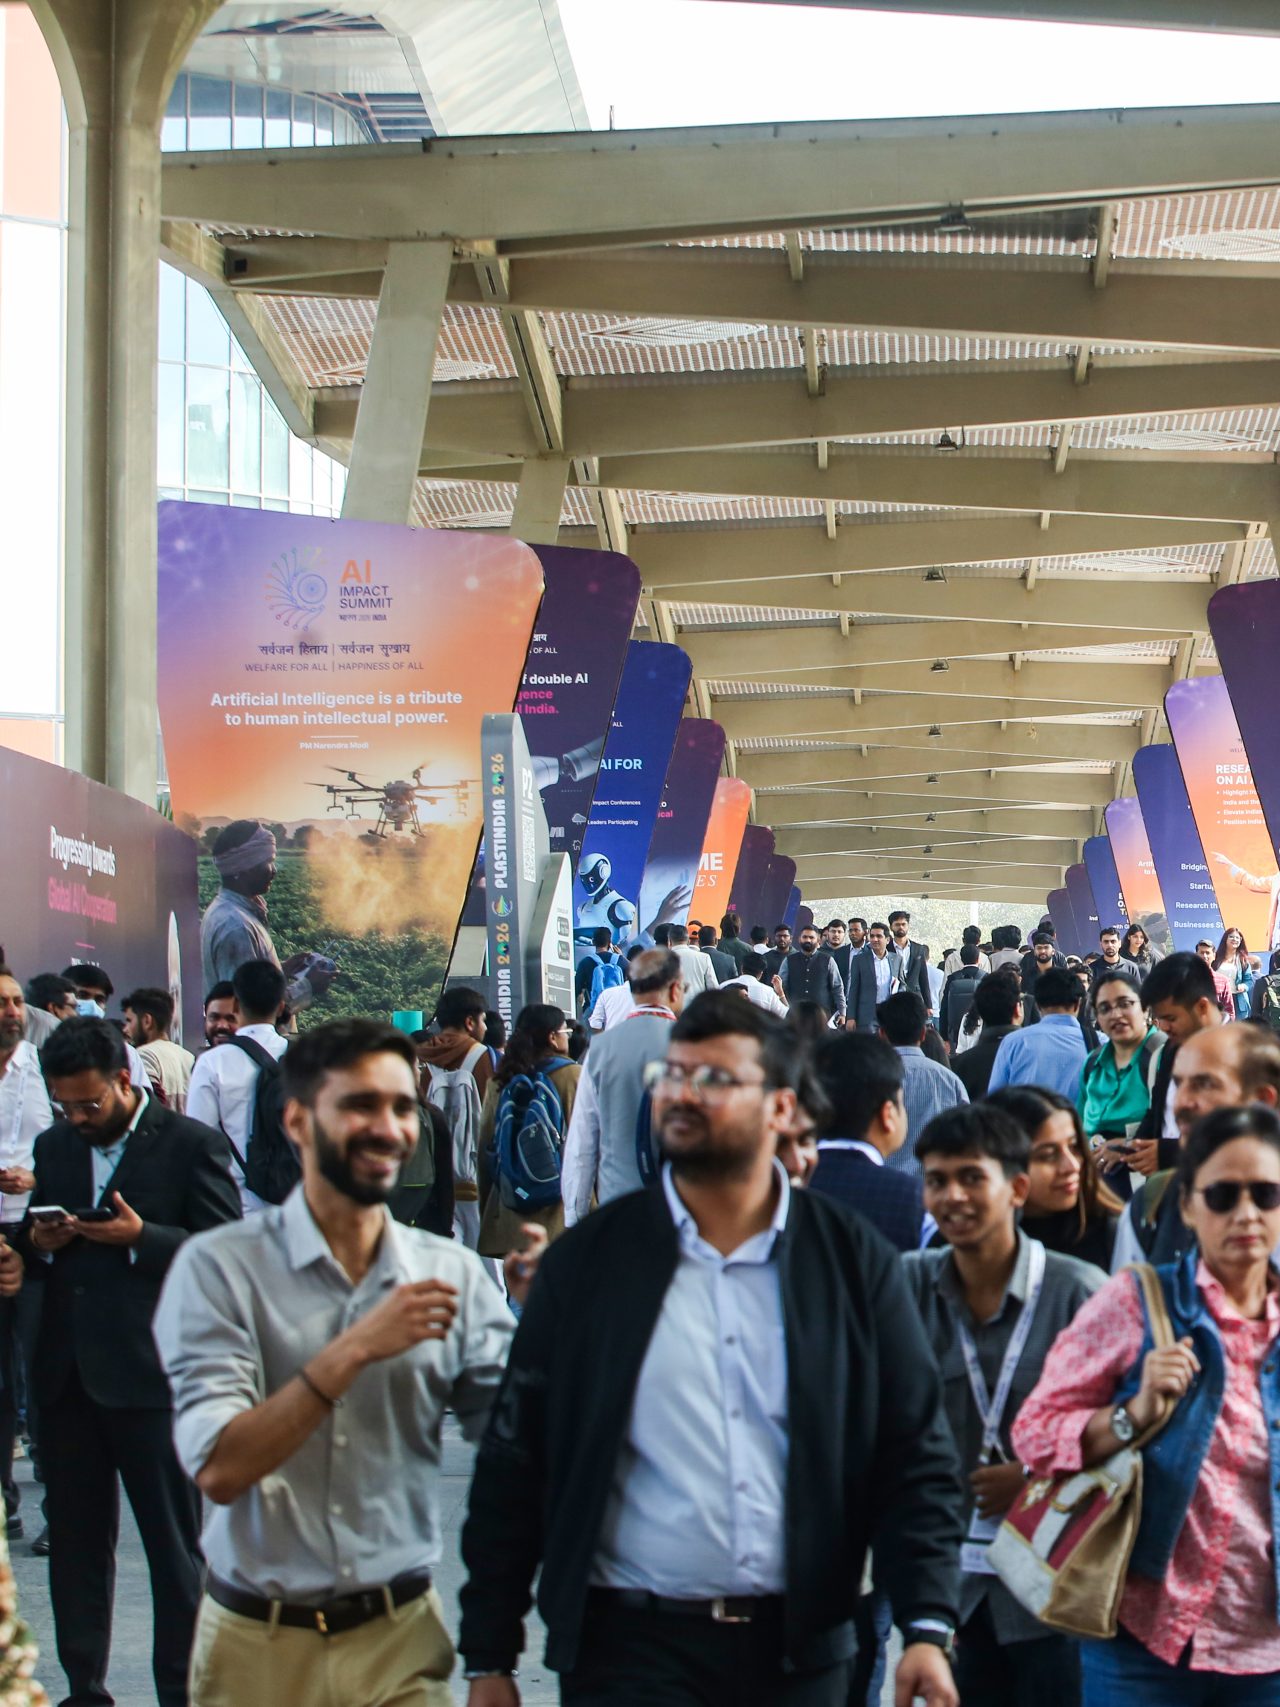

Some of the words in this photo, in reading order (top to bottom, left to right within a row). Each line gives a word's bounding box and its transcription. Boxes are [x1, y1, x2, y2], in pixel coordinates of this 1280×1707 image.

[341, 559, 371, 583] AI
[340, 585, 389, 597] IMPACT
[340, 597, 393, 608] SUMMIT
[299, 641, 328, 655] हिताय
[245, 663, 288, 671] WELFARE
[290, 663, 309, 672] FOR
[311, 663, 328, 671] ALL
[338, 662, 390, 671] HAPPINESS
[392, 662, 405, 670] OF
[407, 662, 424, 670] ALL
[529, 673, 572, 685] double
[575, 672, 588, 683] AI
[210, 692, 278, 706] Artificial
[282, 691, 374, 708] Intelligence
[379, 691, 392, 705] is
[396, 694, 405, 705] a
[409, 690, 463, 704] tribute
[525, 703, 559, 714] India.
[225, 712, 241, 725] to
[245, 712, 299, 726] human
[303, 711, 391, 725] intellectual
[395, 711, 448, 726] power.
[614, 759, 642, 770] FOR
[522, 767, 533, 800] P2
[1216, 775, 1233, 785] ON
[1235, 775, 1247, 785] AI
[492, 799, 508, 889] PLASTINDIA
[50, 825, 93, 877] Progressing
[1175, 901, 1209, 909] Research
[1174, 921, 1215, 929] Businesses
